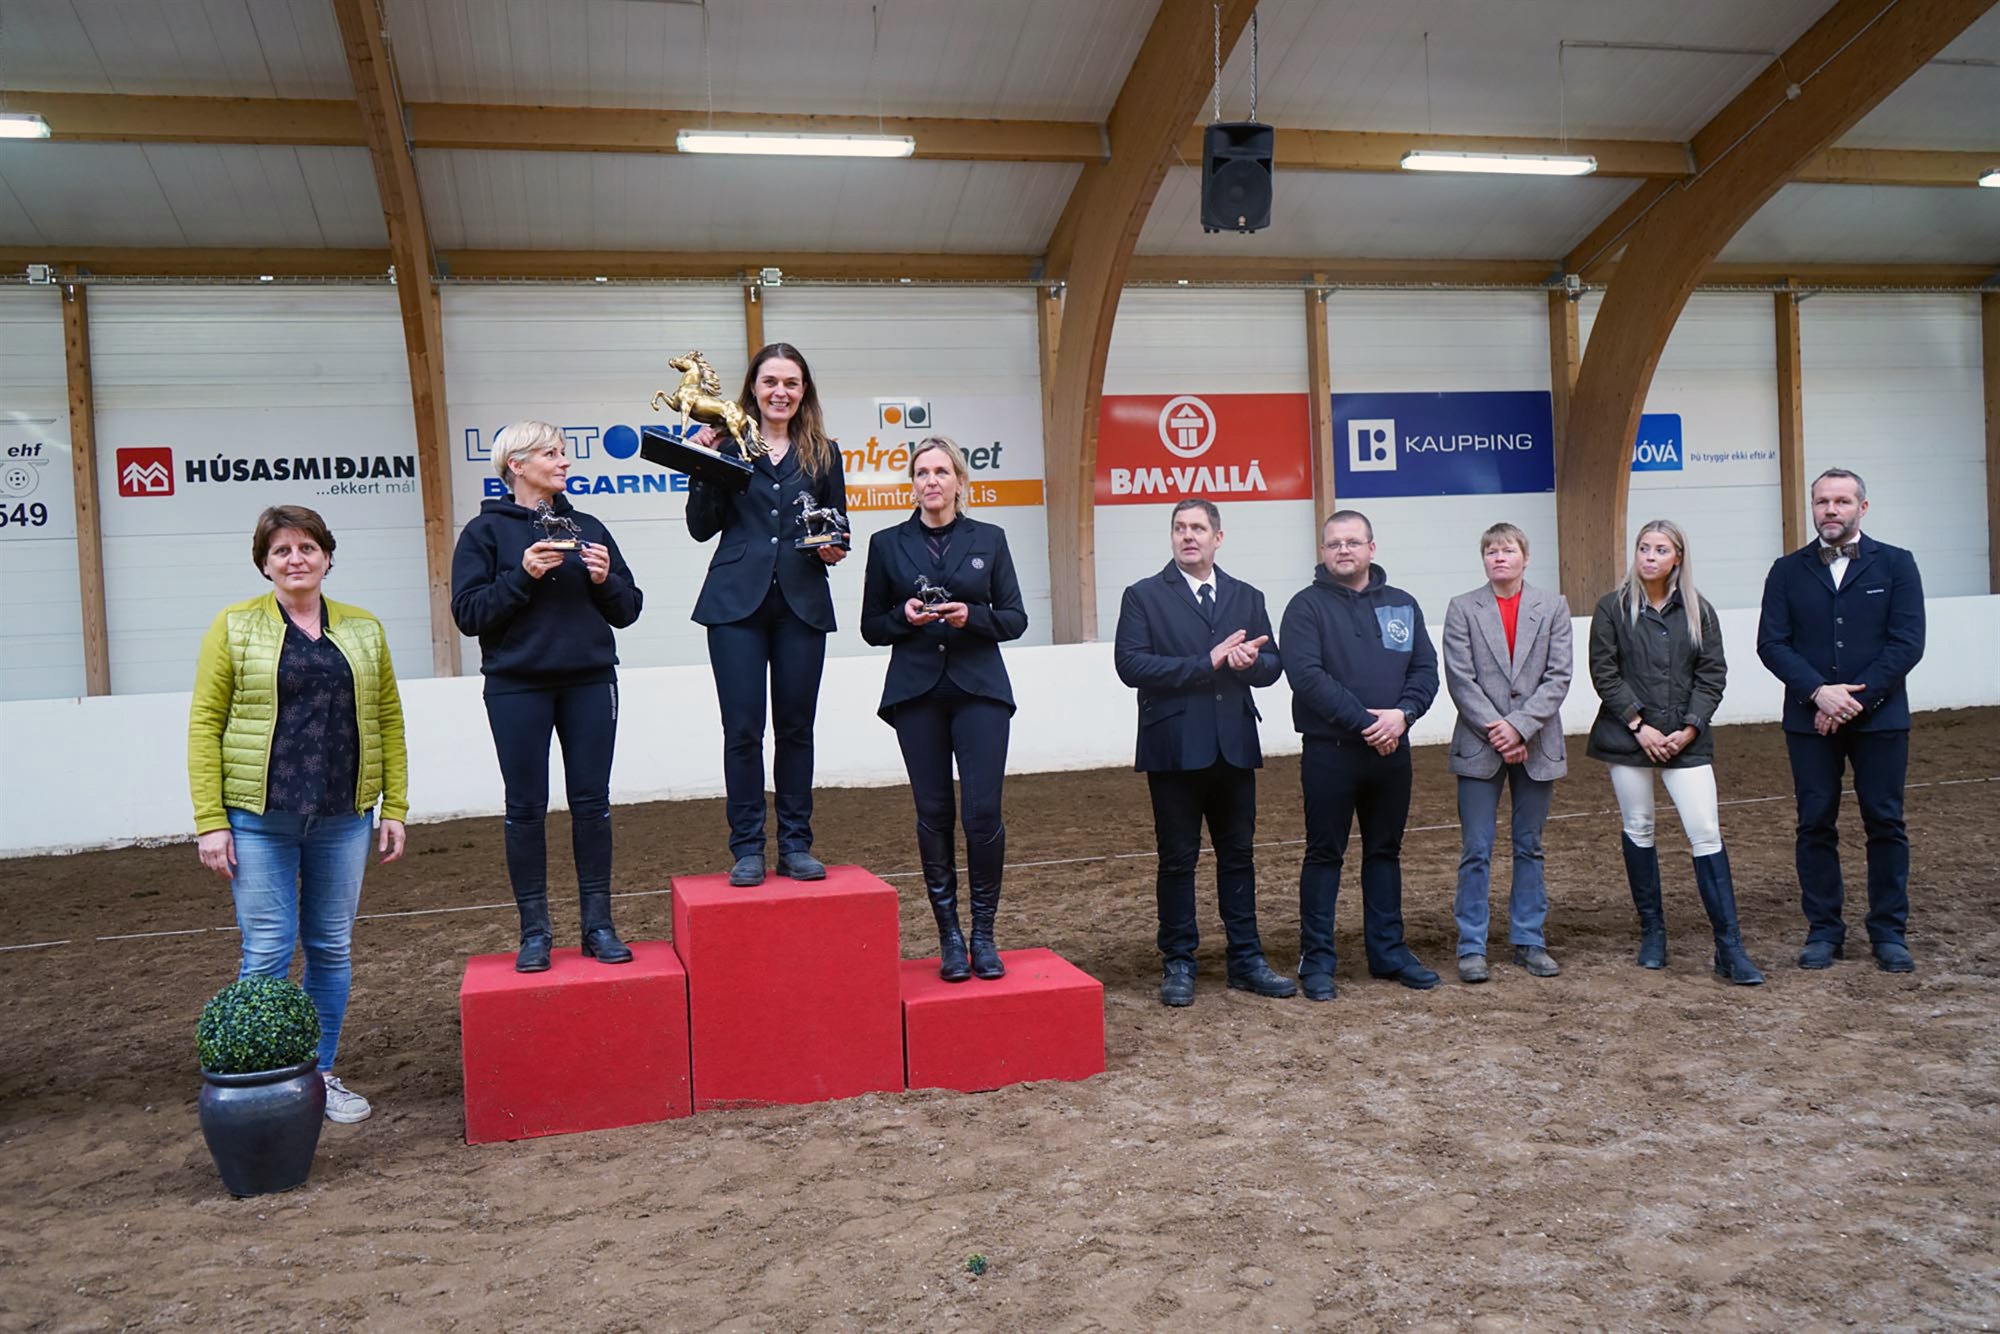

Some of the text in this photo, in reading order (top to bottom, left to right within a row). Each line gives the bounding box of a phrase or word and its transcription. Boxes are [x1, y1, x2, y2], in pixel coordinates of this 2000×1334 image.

[7, 443, 42, 457] ehf
[1690, 452, 1701, 462] Þú
[1703, 452, 1730, 464] tryggir
[1731, 450, 1748, 461] ekki
[1749, 450, 1767, 461] eftir
[185, 453, 416, 484] HÚSASMIÐJAN
[316, 479, 416, 496] ...ekkert mál
